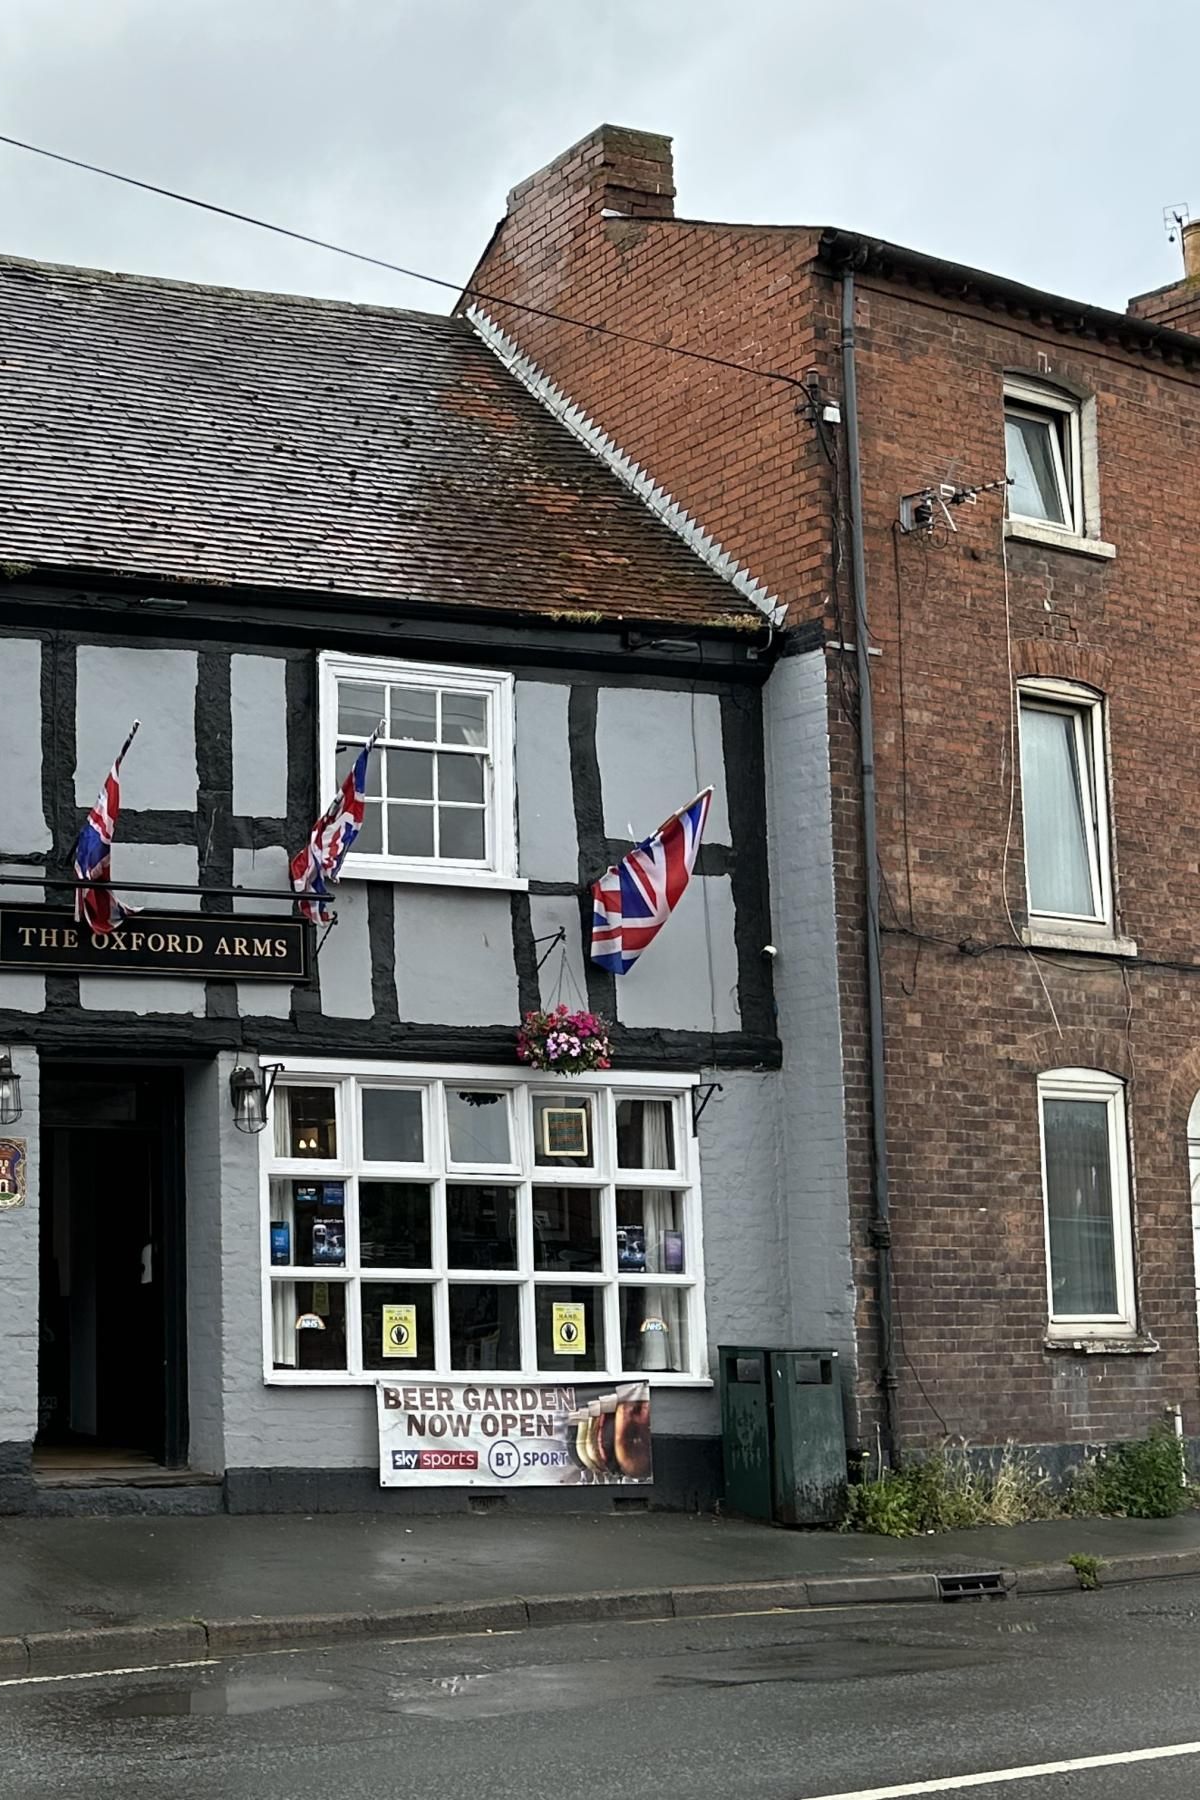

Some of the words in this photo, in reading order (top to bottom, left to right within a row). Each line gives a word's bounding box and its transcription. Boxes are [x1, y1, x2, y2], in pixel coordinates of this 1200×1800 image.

[18, 927, 79, 948] THE
[91, 932, 204, 955] OXFORD
[214, 937, 288, 958] ARMS
[301, 1319, 319, 1328] NHS
[383, 1388, 455, 1411] BEER
[462, 1387, 576, 1412] GARDEN
[407, 1414, 473, 1437] NOW
[480, 1413, 556, 1437] OPEN
[394, 1452, 418, 1468] sky
[423, 1451, 476, 1468] sports
[495, 1452, 514, 1467] BT
[523, 1451, 569, 1467] SPORT
